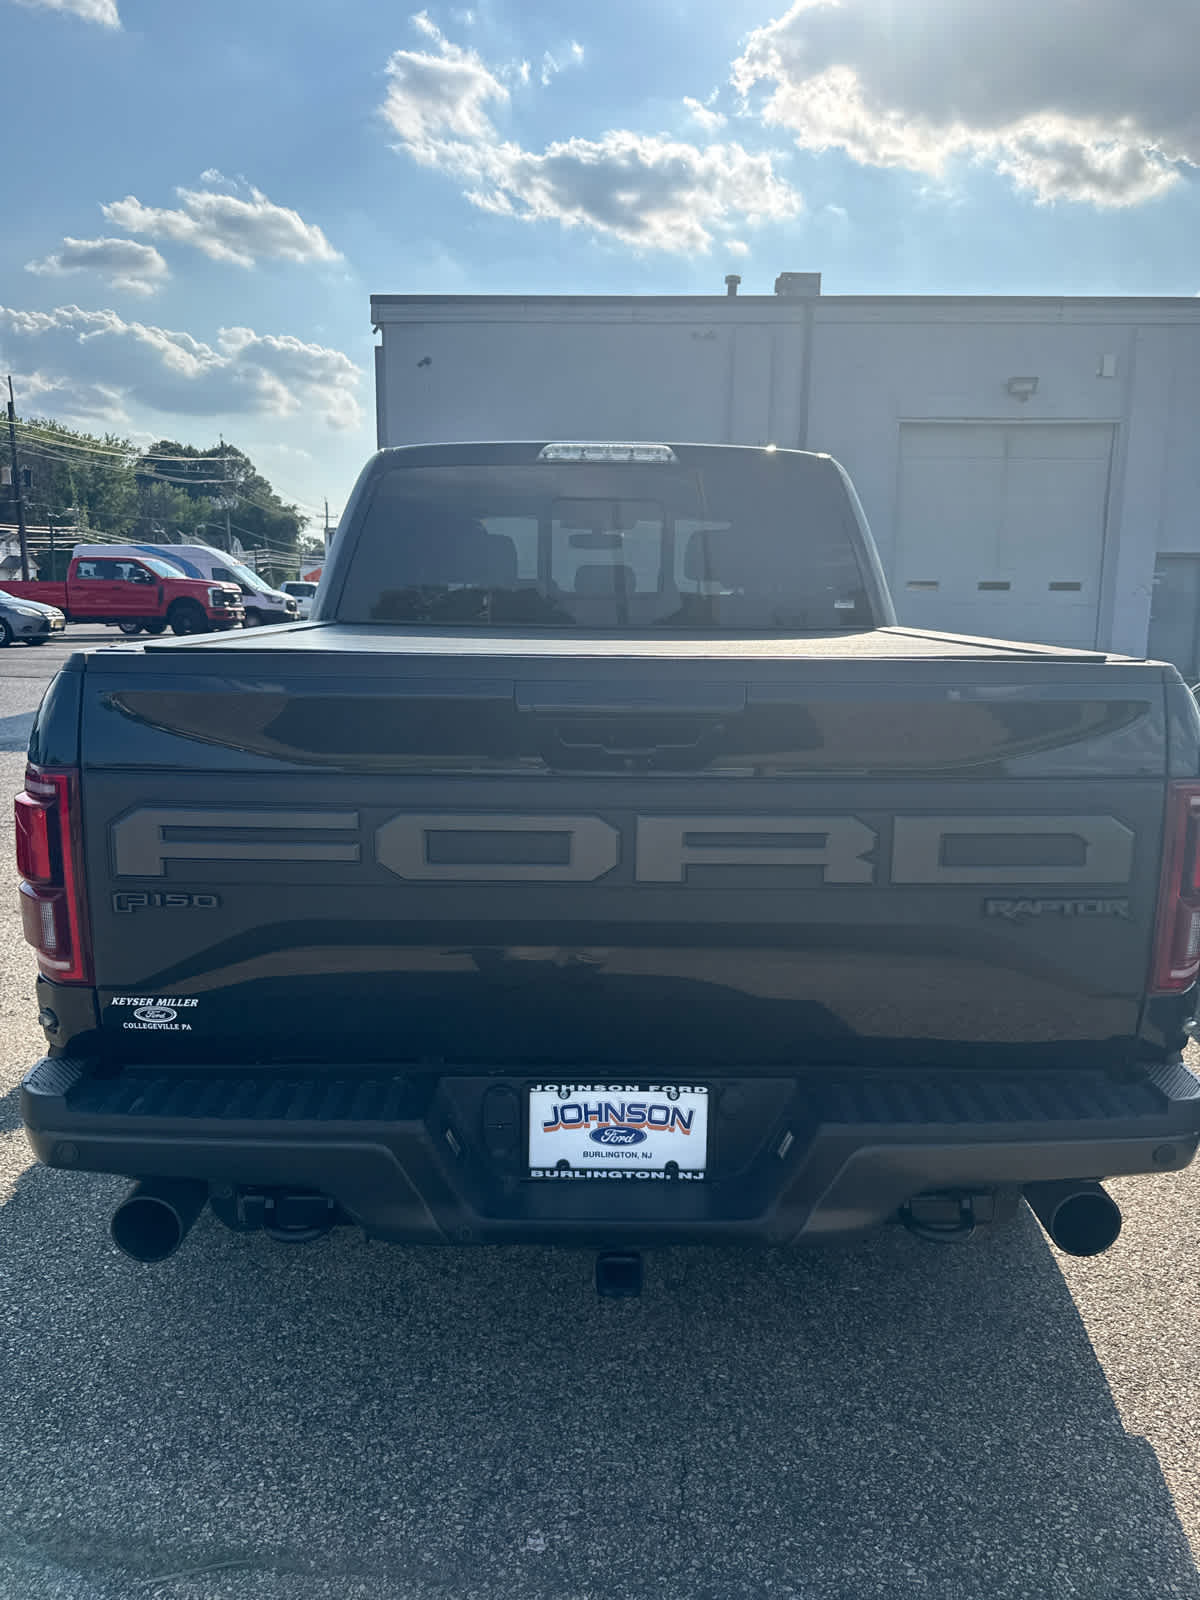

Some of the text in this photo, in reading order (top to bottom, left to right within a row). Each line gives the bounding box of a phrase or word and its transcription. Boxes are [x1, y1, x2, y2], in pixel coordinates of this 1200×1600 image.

[111, 808, 1135, 884] FORD
[984, 896, 1132, 919] RAPTOR
[111, 997, 199, 1007] KEYSER MILLER
[122, 1022, 192, 1031] COLLEGEVILLE PA
[530, 1084, 709, 1094] JOHNSON FORD
[542, 1103, 695, 1133] JOHNSON
[582, 1150, 653, 1160] BURLINGTON, NJ
[530, 1170, 705, 1180] BURLINGTON, NJ
